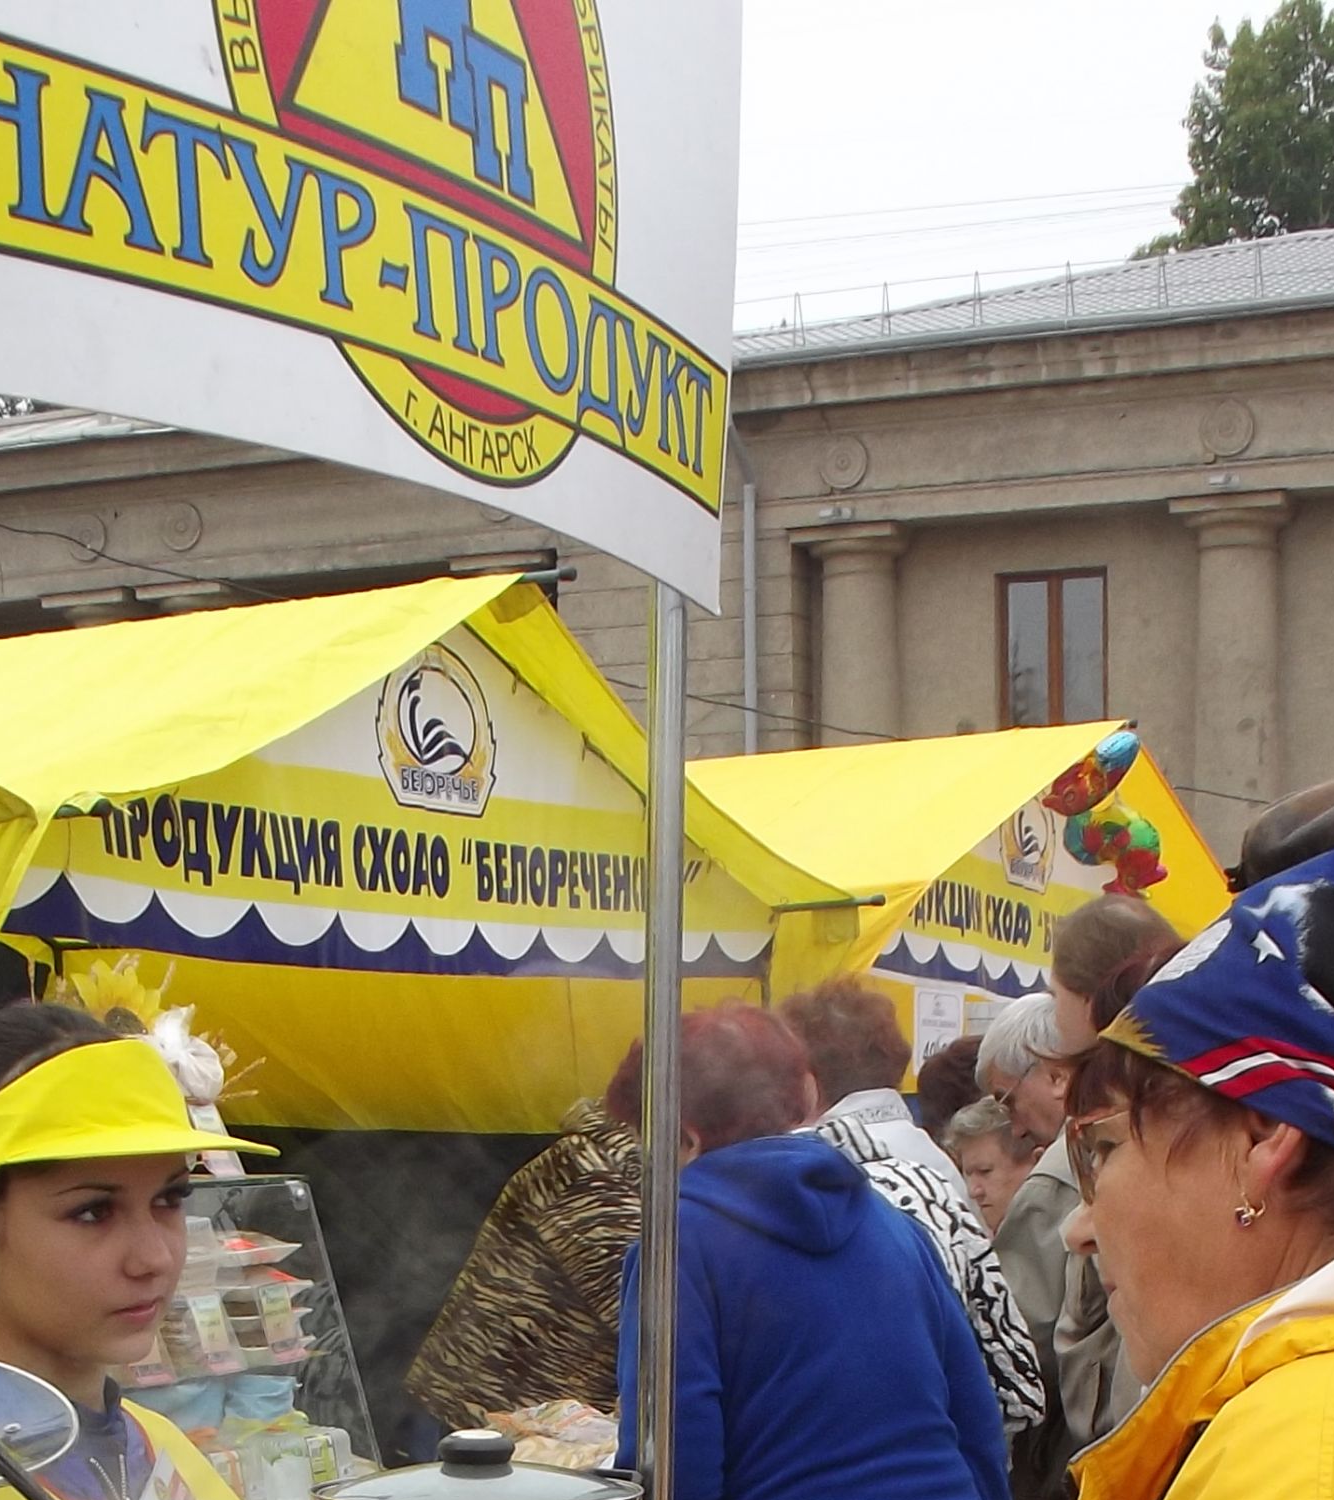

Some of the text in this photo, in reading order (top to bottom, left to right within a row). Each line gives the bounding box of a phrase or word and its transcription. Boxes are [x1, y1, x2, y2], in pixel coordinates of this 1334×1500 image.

[427, 410, 542, 476] АНГАРСК
[100, 793, 344, 896] ПРОДУКЦИЯ
[352, 823, 451, 899] СХОАО
